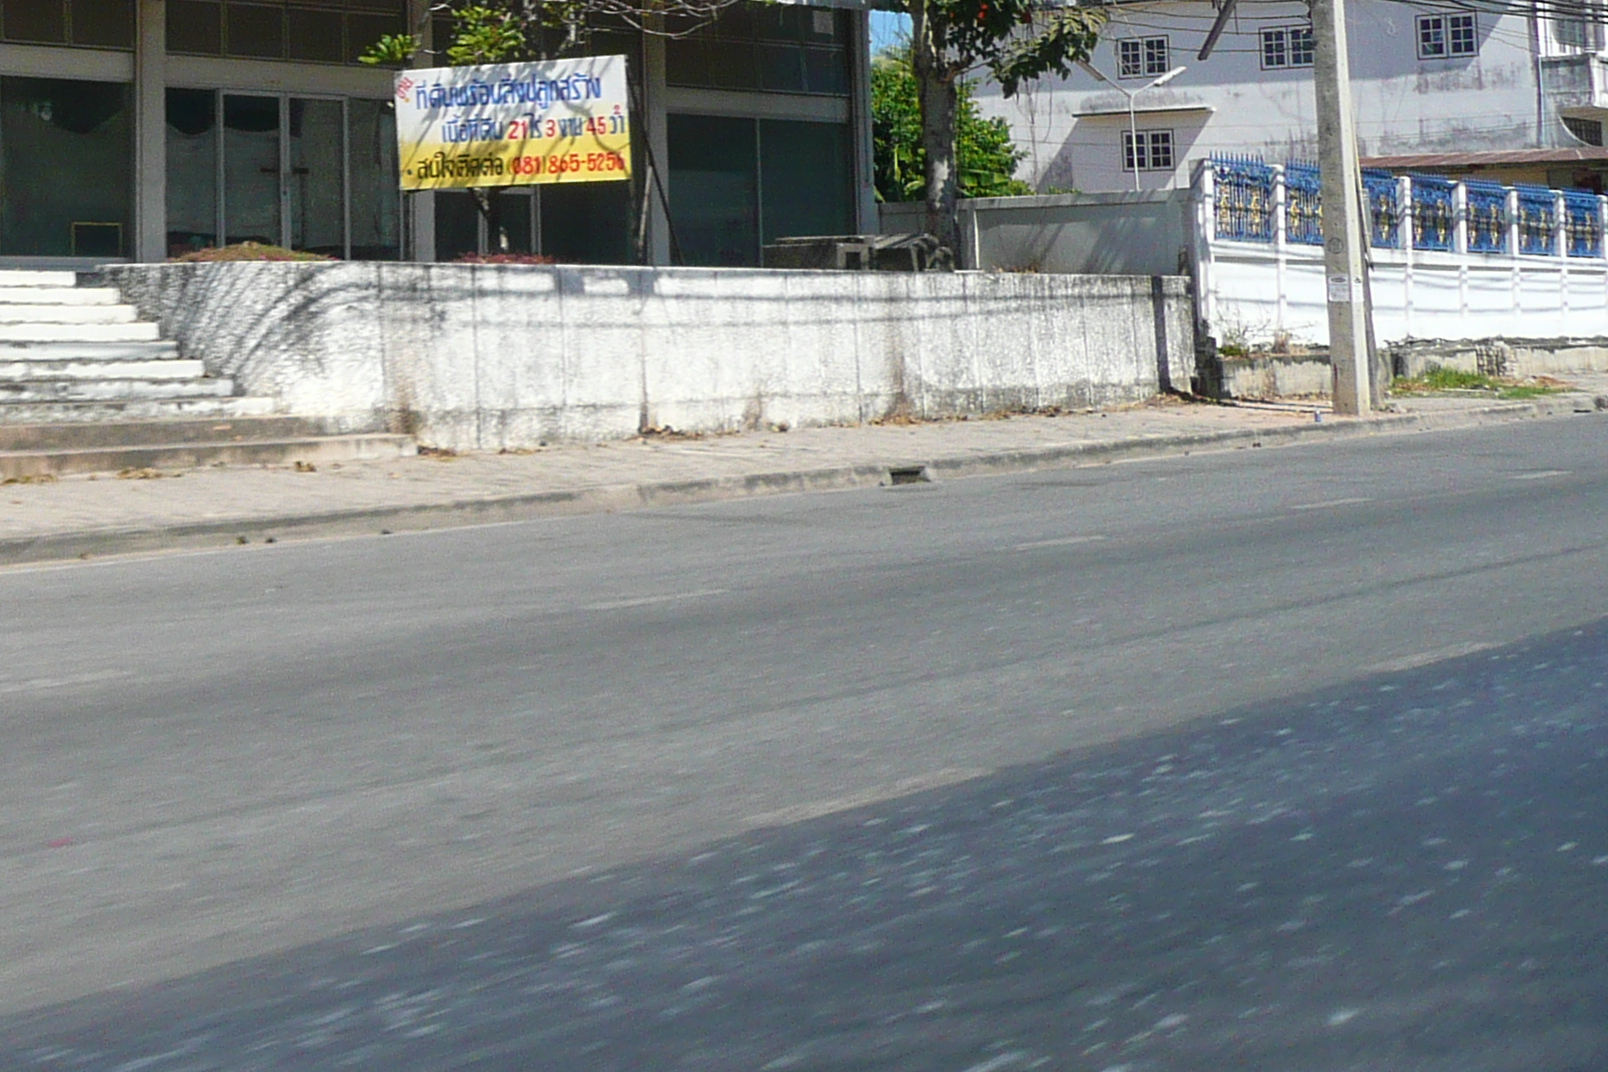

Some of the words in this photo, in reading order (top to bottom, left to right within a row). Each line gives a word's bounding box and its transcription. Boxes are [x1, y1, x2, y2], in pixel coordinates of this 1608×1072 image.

[415, 72, 601, 109] ที่ดินพร้อมสิ่งปลูกสร้าง
[507, 120, 527, 140] 21
[546, 119, 556, 138] 3
[587, 116, 606, 136] 45
[417, 151, 503, 179] สนใจติดต่อ
